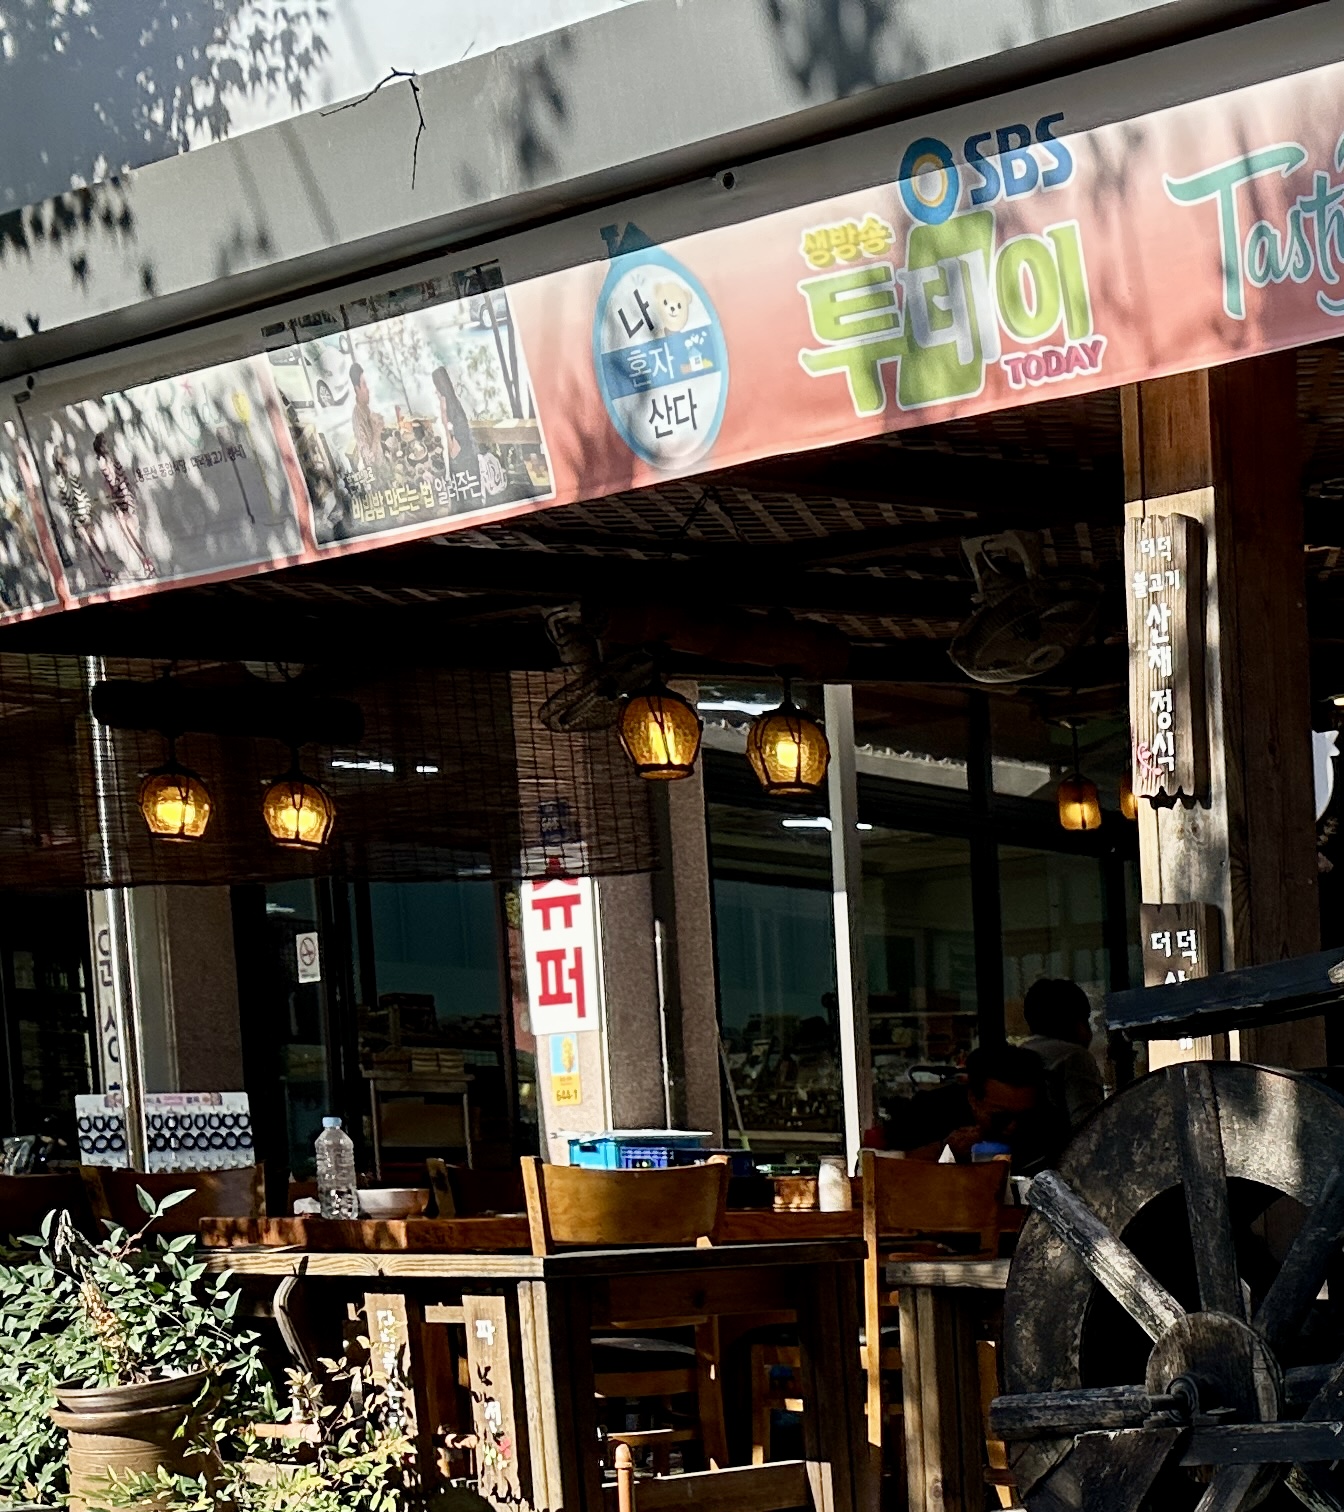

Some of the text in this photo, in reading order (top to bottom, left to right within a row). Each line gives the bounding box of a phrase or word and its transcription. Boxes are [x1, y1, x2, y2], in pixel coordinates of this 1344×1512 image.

[964, 112, 1073, 206] SBS
[804, 217, 894, 266] 생방송
[617, 289, 655, 339] 나
[798, 220, 1094, 413] 투데이
[626, 342, 675, 388] 혼자
[1004, 339, 1104, 386] TODAY
[648, 388, 698, 439] 산다
[352, 489, 385, 523] 비빔밥
[384, 483, 421, 517] 만드는
[420, 480, 435, 509] 법
[1140, 535, 1172, 563] 더덕
[1132, 568, 1181, 600] 불고기
[1145, 602, 1176, 773] 산채 정식
[530, 856, 587, 1018] 슈퍼
[1150, 928, 1199, 965] 더덕
